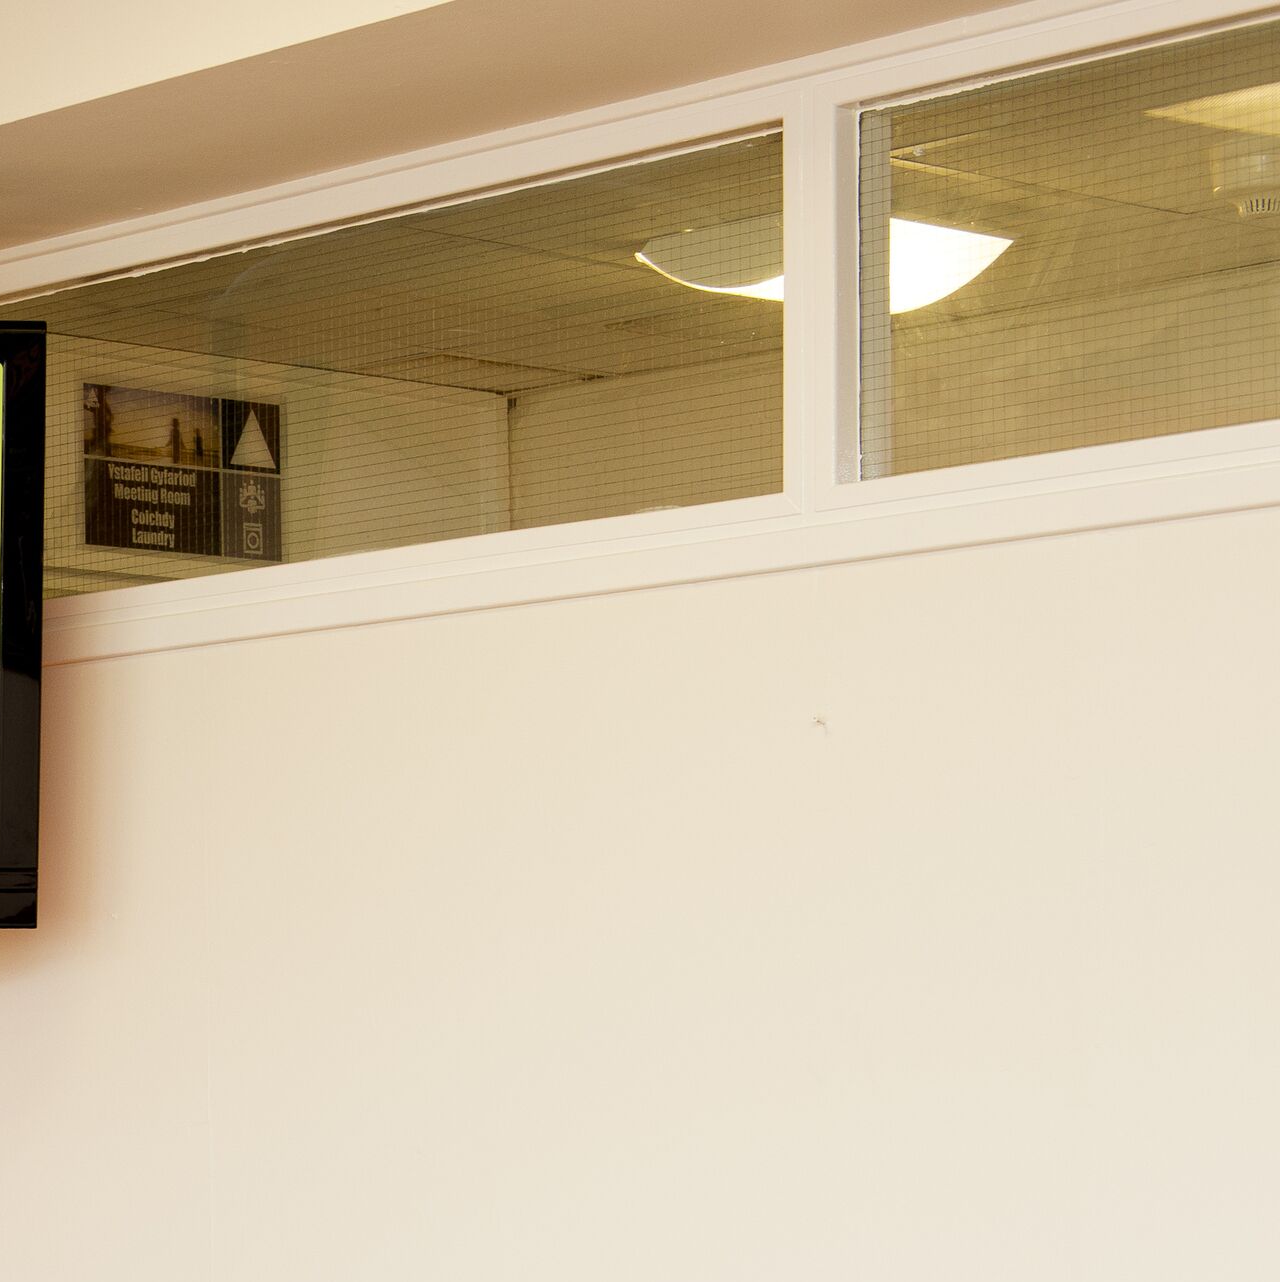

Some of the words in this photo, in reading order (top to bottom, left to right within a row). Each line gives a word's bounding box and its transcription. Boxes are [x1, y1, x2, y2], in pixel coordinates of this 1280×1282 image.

[108, 463, 149, 482] Ystafell
[150, 467, 196, 487] Gyfarfod
[114, 483, 159, 505] Meeting
[160, 487, 191, 506] Room
[132, 528, 175, 548] Laundry
